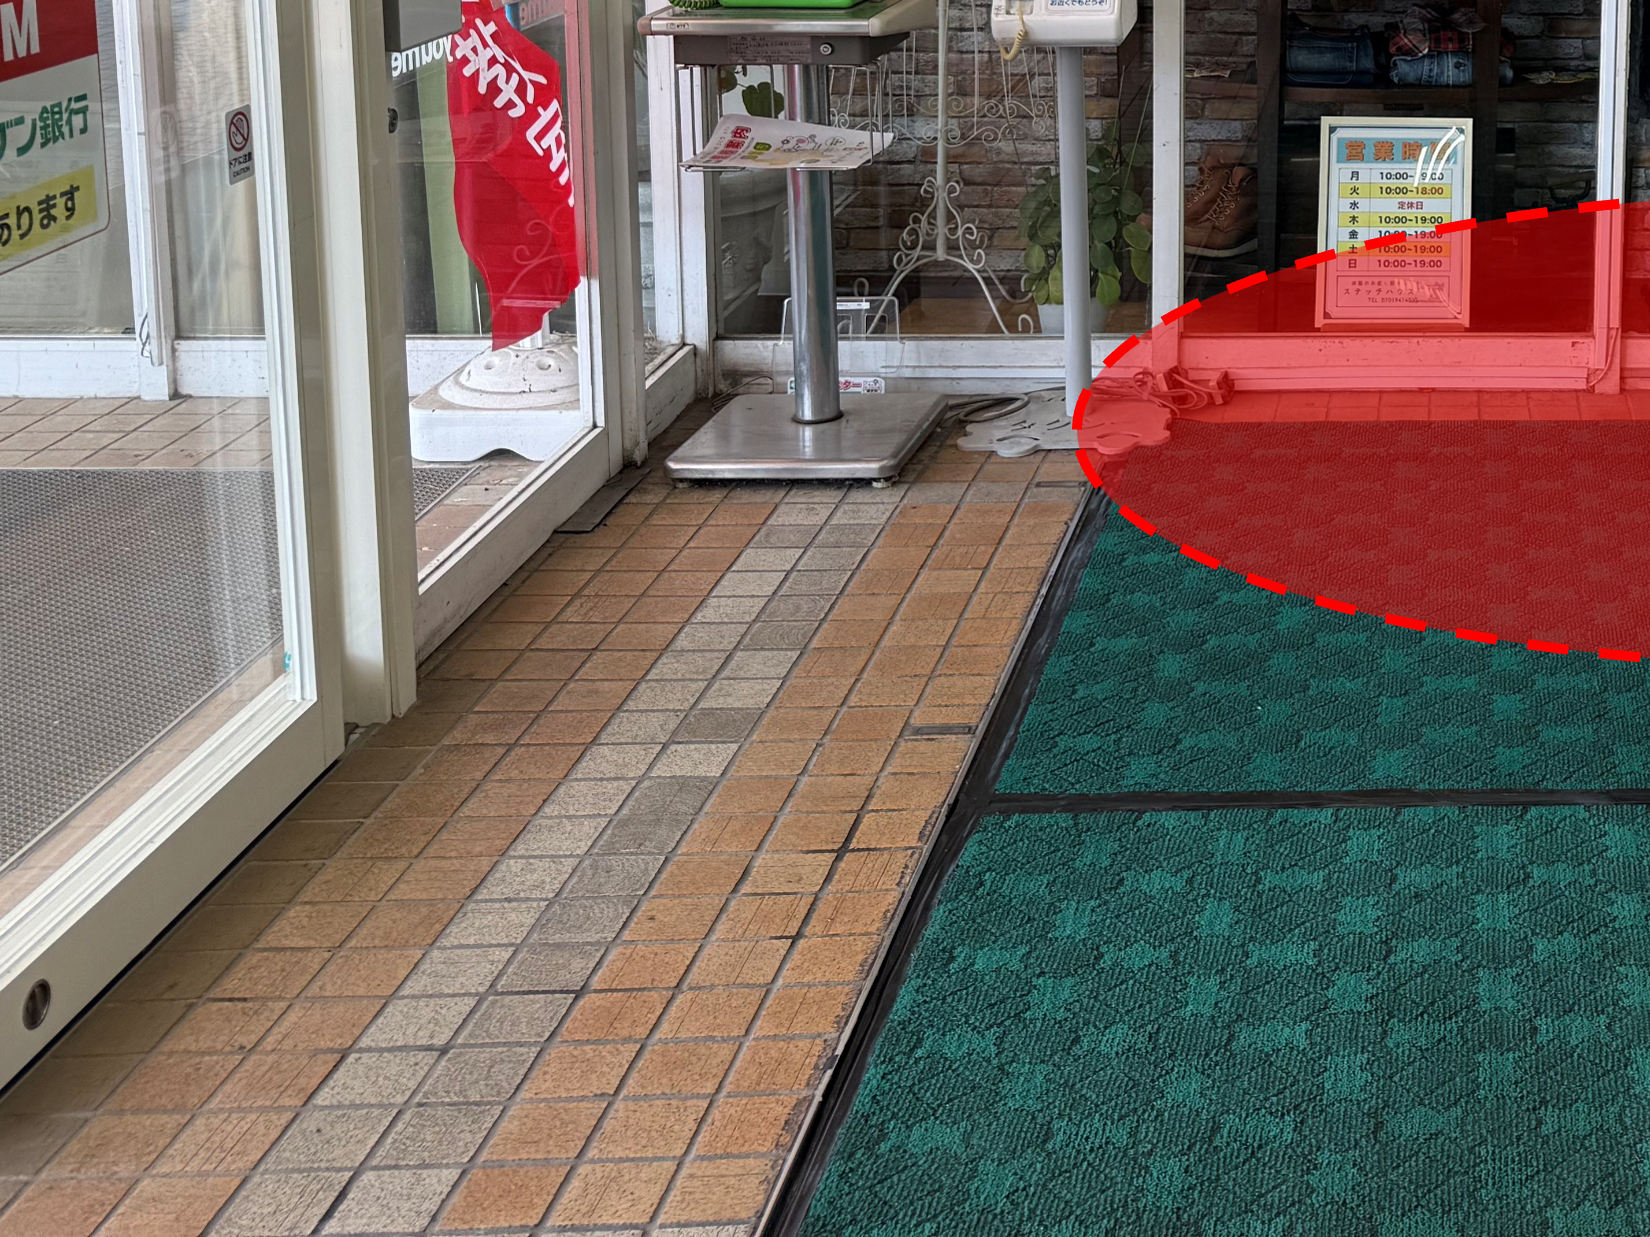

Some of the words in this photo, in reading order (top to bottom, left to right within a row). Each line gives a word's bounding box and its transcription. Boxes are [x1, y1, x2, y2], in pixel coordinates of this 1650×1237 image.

[1350, 171, 1359, 180] 月
[1350, 186, 1359, 195] 火
[1350, 201, 1359, 210] 水
[1398, 202, 1423, 210] 定休日
[1349, 215, 1359, 225] 木
[1349, 230, 1358, 239] 金
[1349, 245, 1358, 254] 土
[1348, 260, 1357, 268] 日
